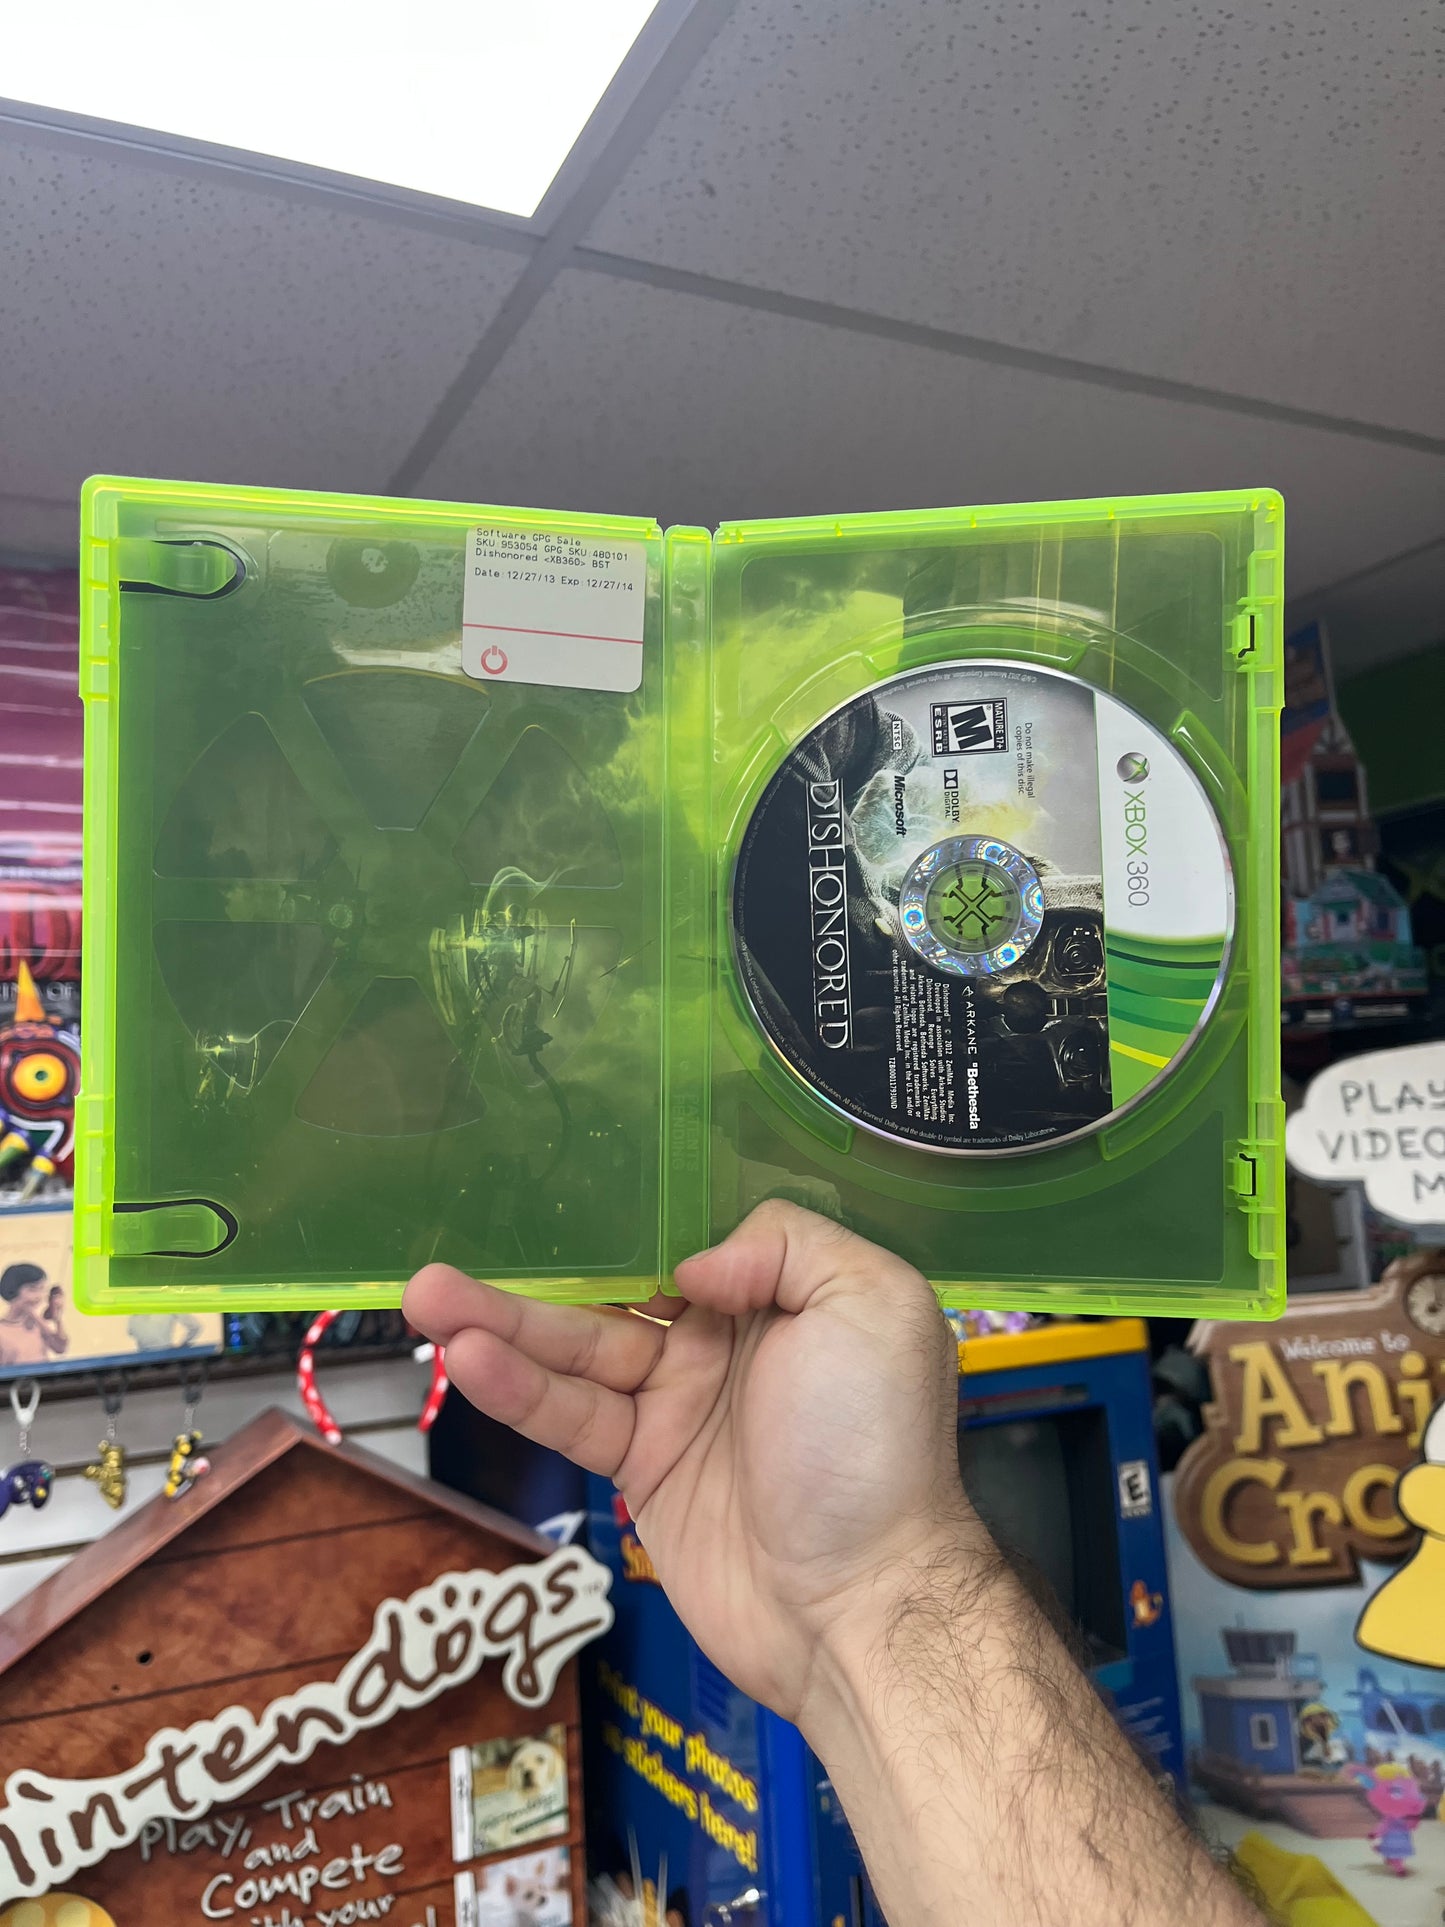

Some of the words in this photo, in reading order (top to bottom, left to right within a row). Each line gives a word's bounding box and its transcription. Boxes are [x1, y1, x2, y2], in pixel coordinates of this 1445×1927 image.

[477, 528, 526, 541] Software
[533, 533, 550, 543] GPG
[557, 537, 581, 546] Sale
[475, 548, 538, 562] Dishonored
[544, 556, 586, 567] <XB360>
[592, 560, 610, 569] BST
[501, 540, 538, 551] 953054
[544, 545, 563, 554] GPG
[593, 550, 628, 561] 480101
[507, 571, 555, 583] 12/27/13
[587, 579, 633, 591] 12/27/14
[934, 707, 942, 753] ESRB
[950, 706, 993, 750] M
[995, 702, 1004, 734] MATURE
[1024, 722, 1033, 733] Do
[893, 723, 902, 748] NTSC
[996, 736, 1004, 749] 17+
[1015, 726, 1024, 751] copies
[1025, 736, 1033, 750] not
[1017, 753, 1025, 761] of
[1026, 752, 1034, 773] make
[1018, 779, 1026, 795] disc.
[1025, 775, 1035, 799] illegal
[894, 775, 907, 836] Microsoft
[951, 791, 960, 822] DOLBY
[1123, 790, 1148, 857] XBOX
[1126, 861, 1150, 906] 360
[808, 779, 848, 1049] DISHONORED
[900, 960, 908, 993] trademarks
[934, 982, 942, 1013] Developed
[893, 1005, 901, 1023] Rights
[902, 1003, 910, 1027] ZeniMax
[910, 1007, 918, 1024] logos
[927, 1023, 935, 1049] Revenge
[936, 1025, 944, 1057] association
[966, 1001, 977, 1055] ARKANE
[911, 1041, 920, 1070] registered
[920, 1031, 928, 1059] Bethesda
[929, 1059, 937, 1078] Solves
[946, 1060, 954, 1085] ZeniMax
[888, 1057, 897, 1109] TZB00011793UND
[906, 1096, 914, 1116] and/or
[922, 1095, 930, 1120] ZeniMax
[939, 1100, 947, 1123] Studios.
[967, 1068, 980, 1130] Bethesda
[883, 1117, 899, 1130] Dolby
[898, 1123, 910, 1133] and
[908, 1126, 919, 1135] the
[942, 1133, 962, 1143] symbol
[1007, 1132, 1023, 1142] Dolby
[1278, 1336, 1375, 1360] Welcome
[1379, 1330, 1410, 1351] to
[1127, 1474, 1143, 1500] E
[640, 1698, 684, 1749] your
[685, 1732, 758, 1813] photos
[263, 1773, 392, 1829] Train
[623, 1737, 699, 1820] stickers
[699, 1791, 758, 1873] here!
[244, 1827, 319, 1869] and
[201, 1844, 404, 1918] Compete
